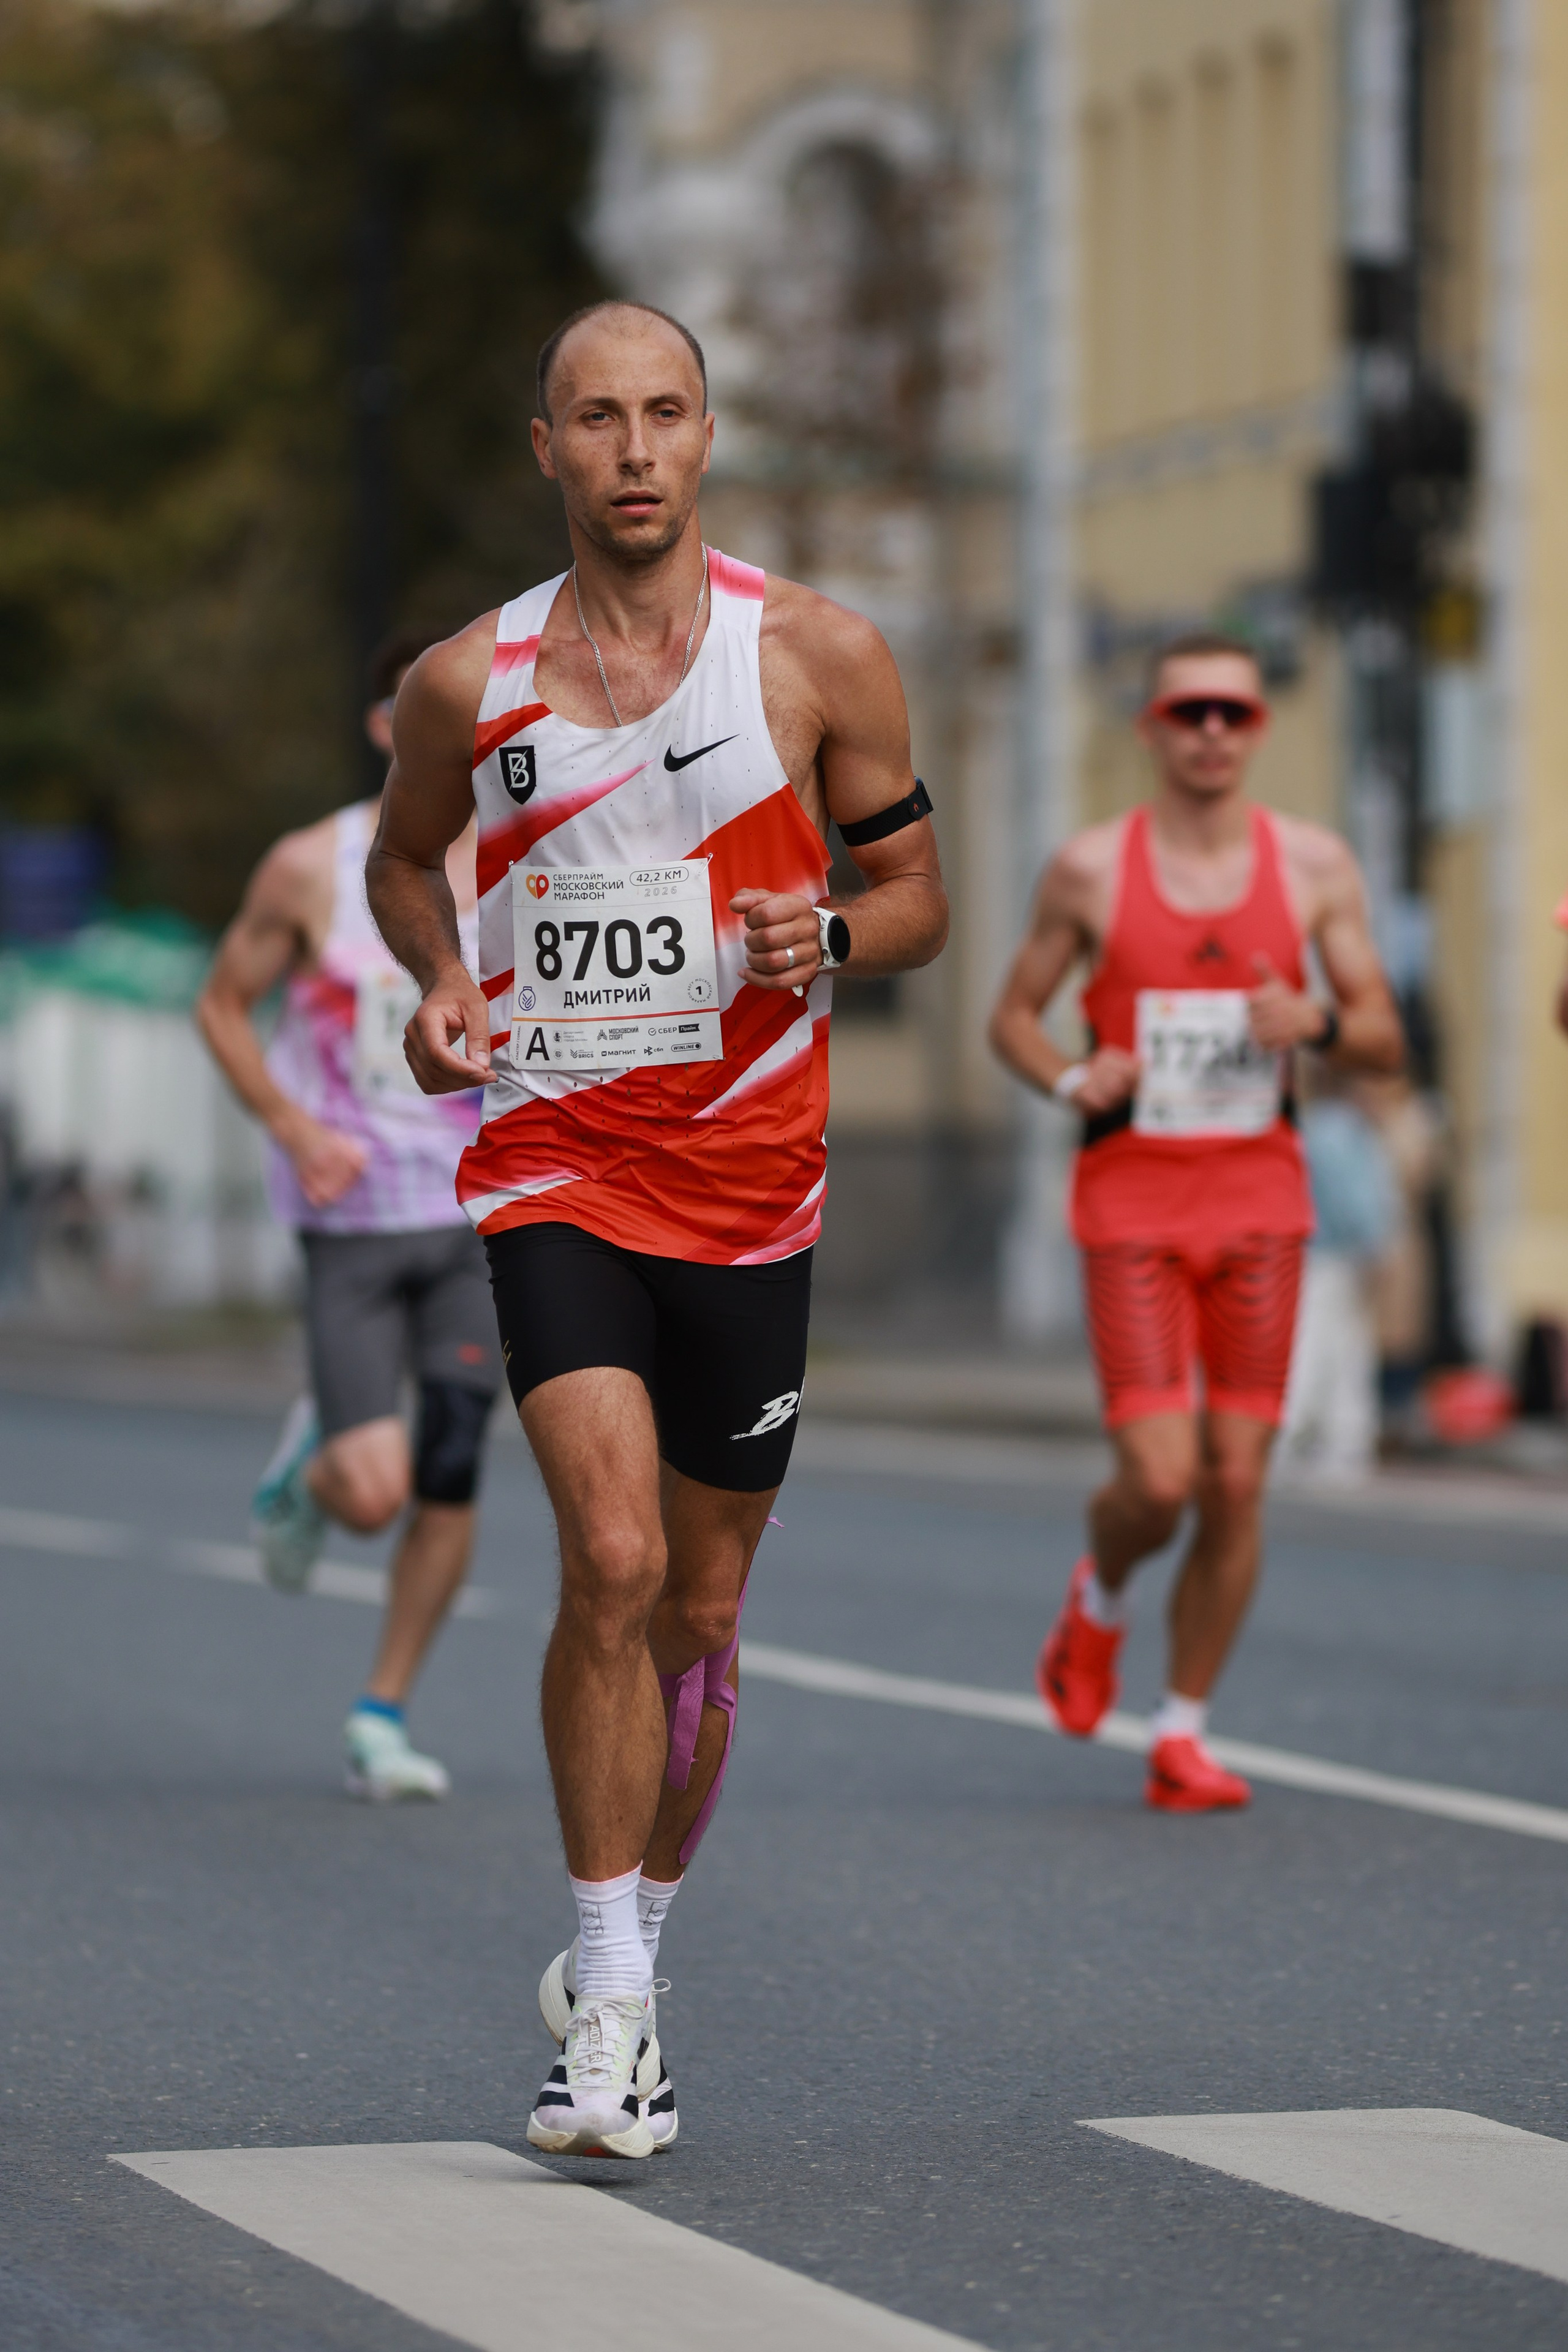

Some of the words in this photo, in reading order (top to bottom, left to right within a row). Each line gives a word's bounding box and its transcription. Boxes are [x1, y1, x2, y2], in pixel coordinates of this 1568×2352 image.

[553, 872, 603, 881] СБЕРПРАЙМ
[636, 872, 660, 883] 42,2
[665, 870, 681, 880] КМ
[554, 880, 624, 891] МОСКОВСКИЙ
[554, 892, 605, 900] МАРАФОН
[644, 886, 677, 897] 2026
[534, 916, 685, 981] 8703
[564, 983, 650, 1009] ДМИТРИЙ
[696, 986, 702, 995] 1
